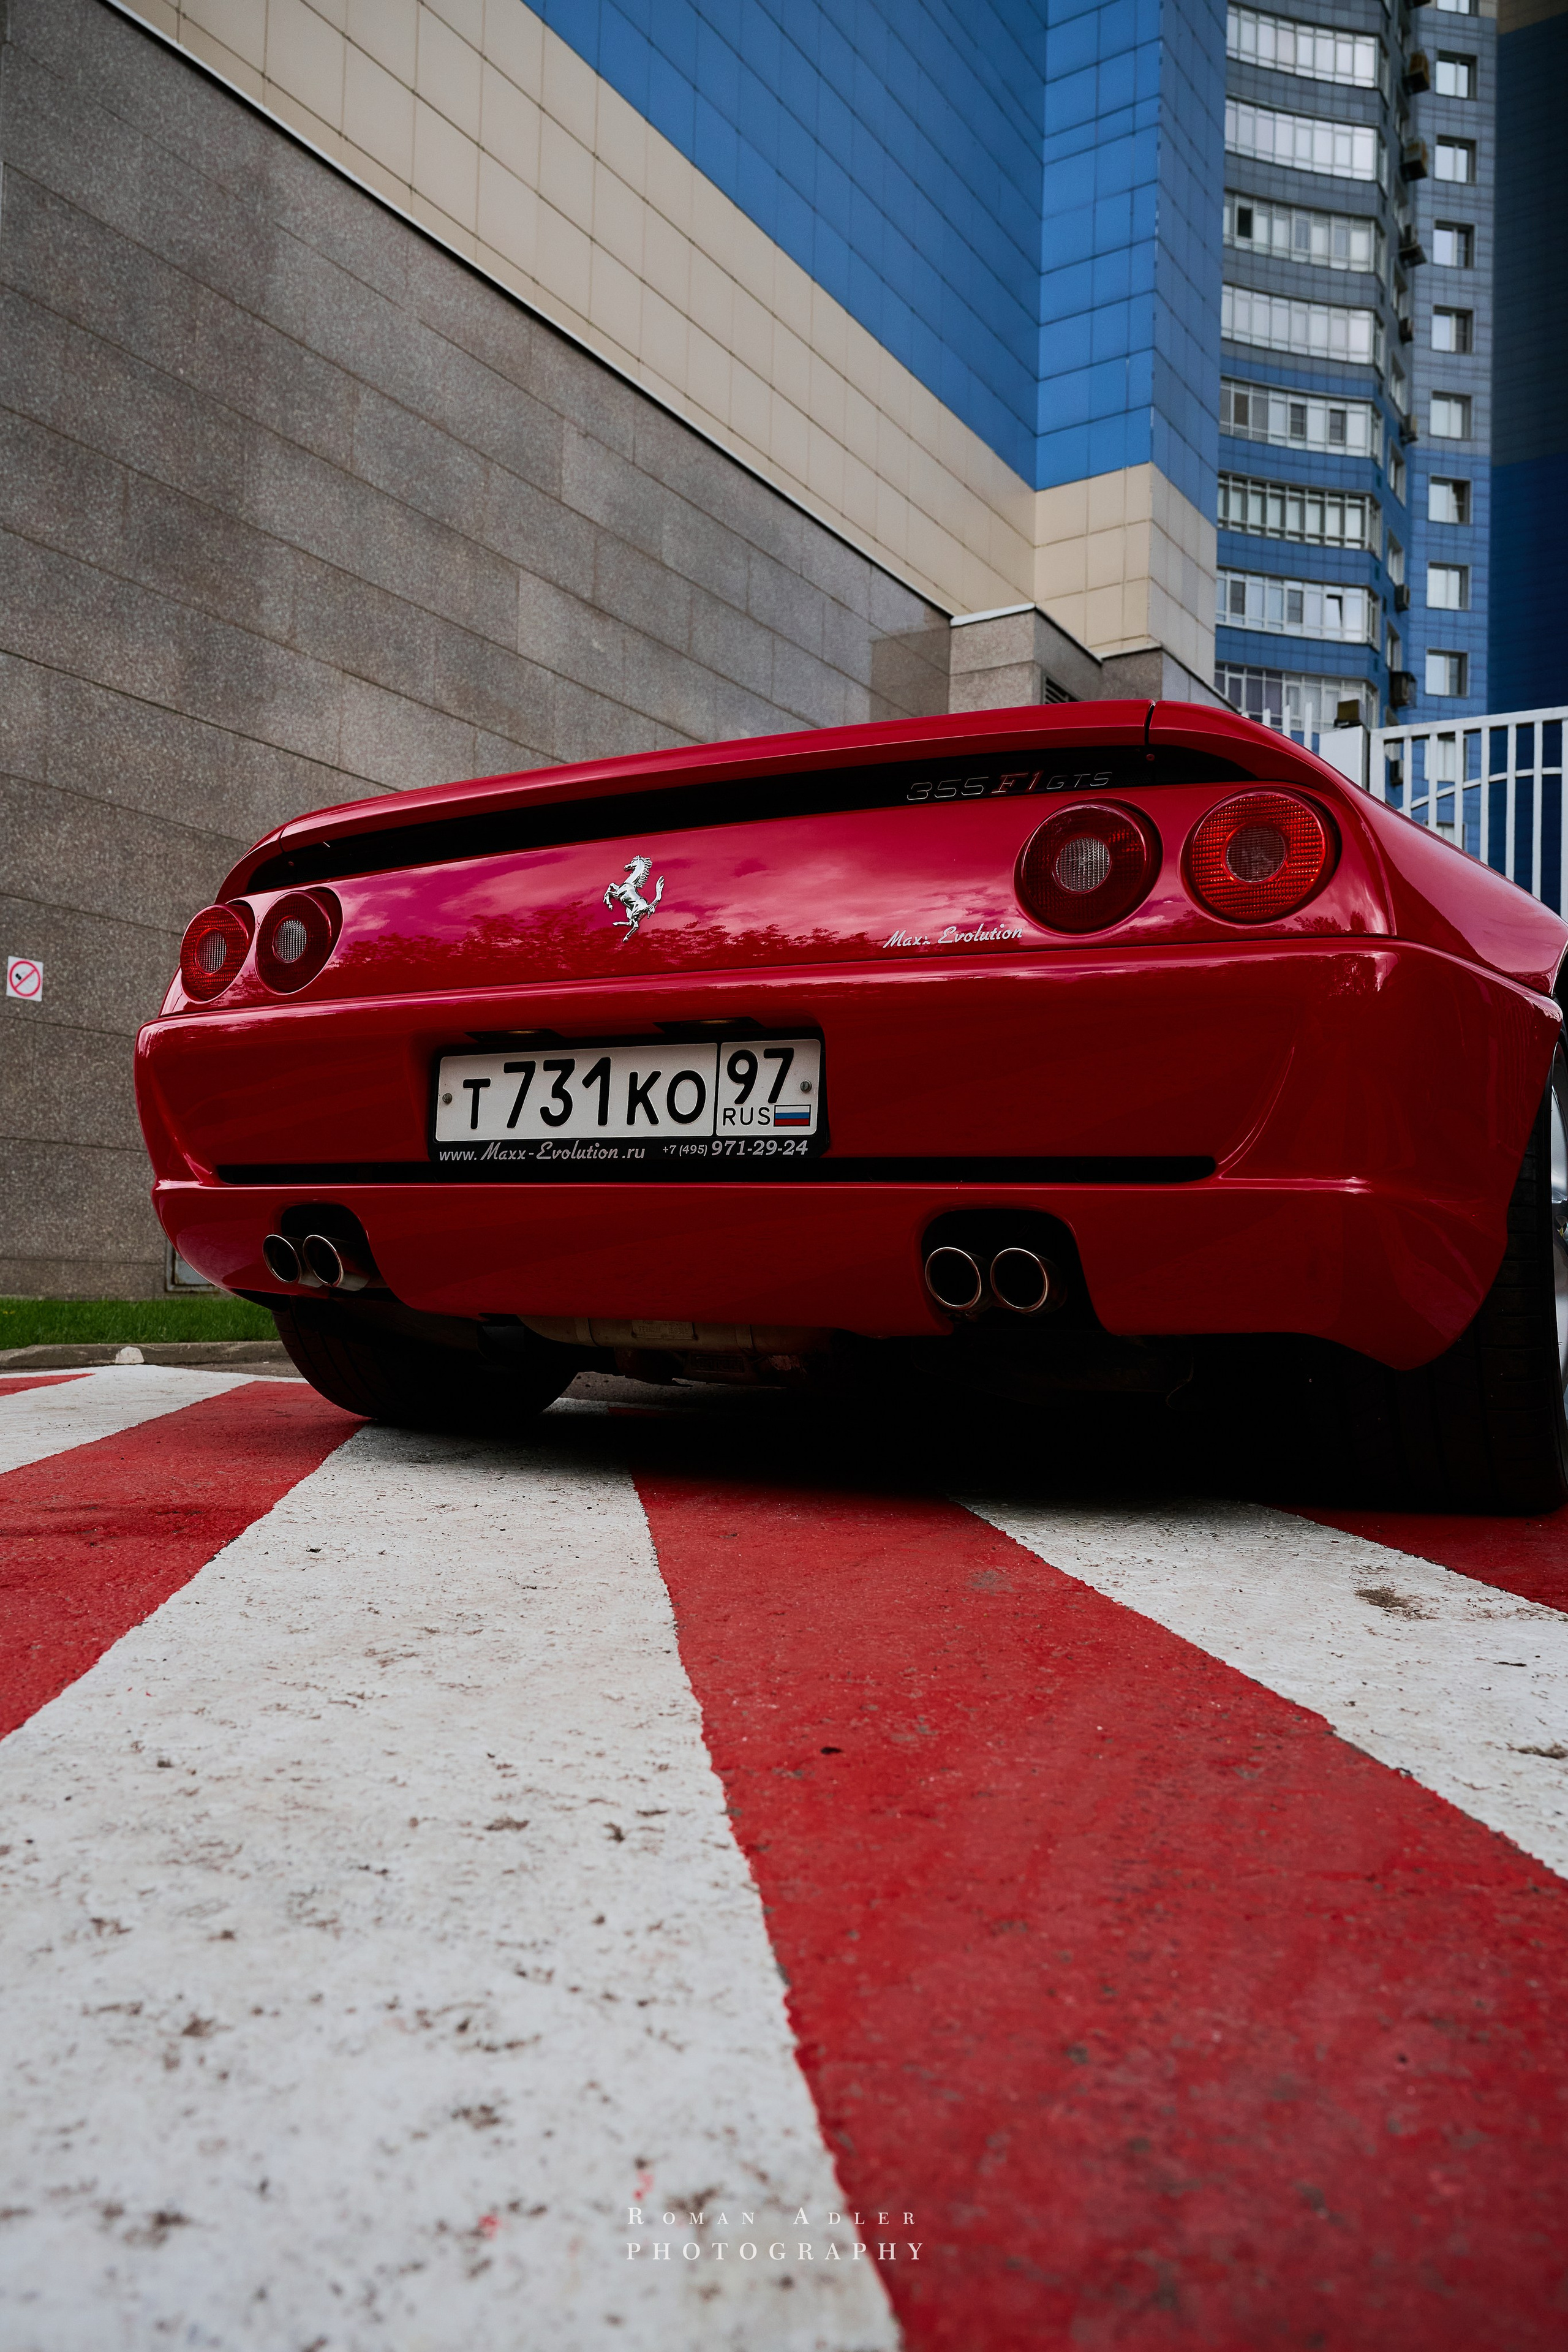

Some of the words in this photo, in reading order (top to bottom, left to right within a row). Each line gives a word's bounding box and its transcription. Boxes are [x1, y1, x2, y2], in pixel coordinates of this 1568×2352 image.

[907, 776, 989, 801] 355
[990, 771, 1044, 796] F1
[1046, 772, 1113, 790] GTS
[937, 923, 1023, 944] Evolution
[726, 1047, 794, 1105] 97
[723, 1106, 771, 1126] RUS
[663, 1145, 676, 1155] +7
[679, 1145, 707, 1156] (495)
[712, 1140, 809, 1156] 971-29-24
